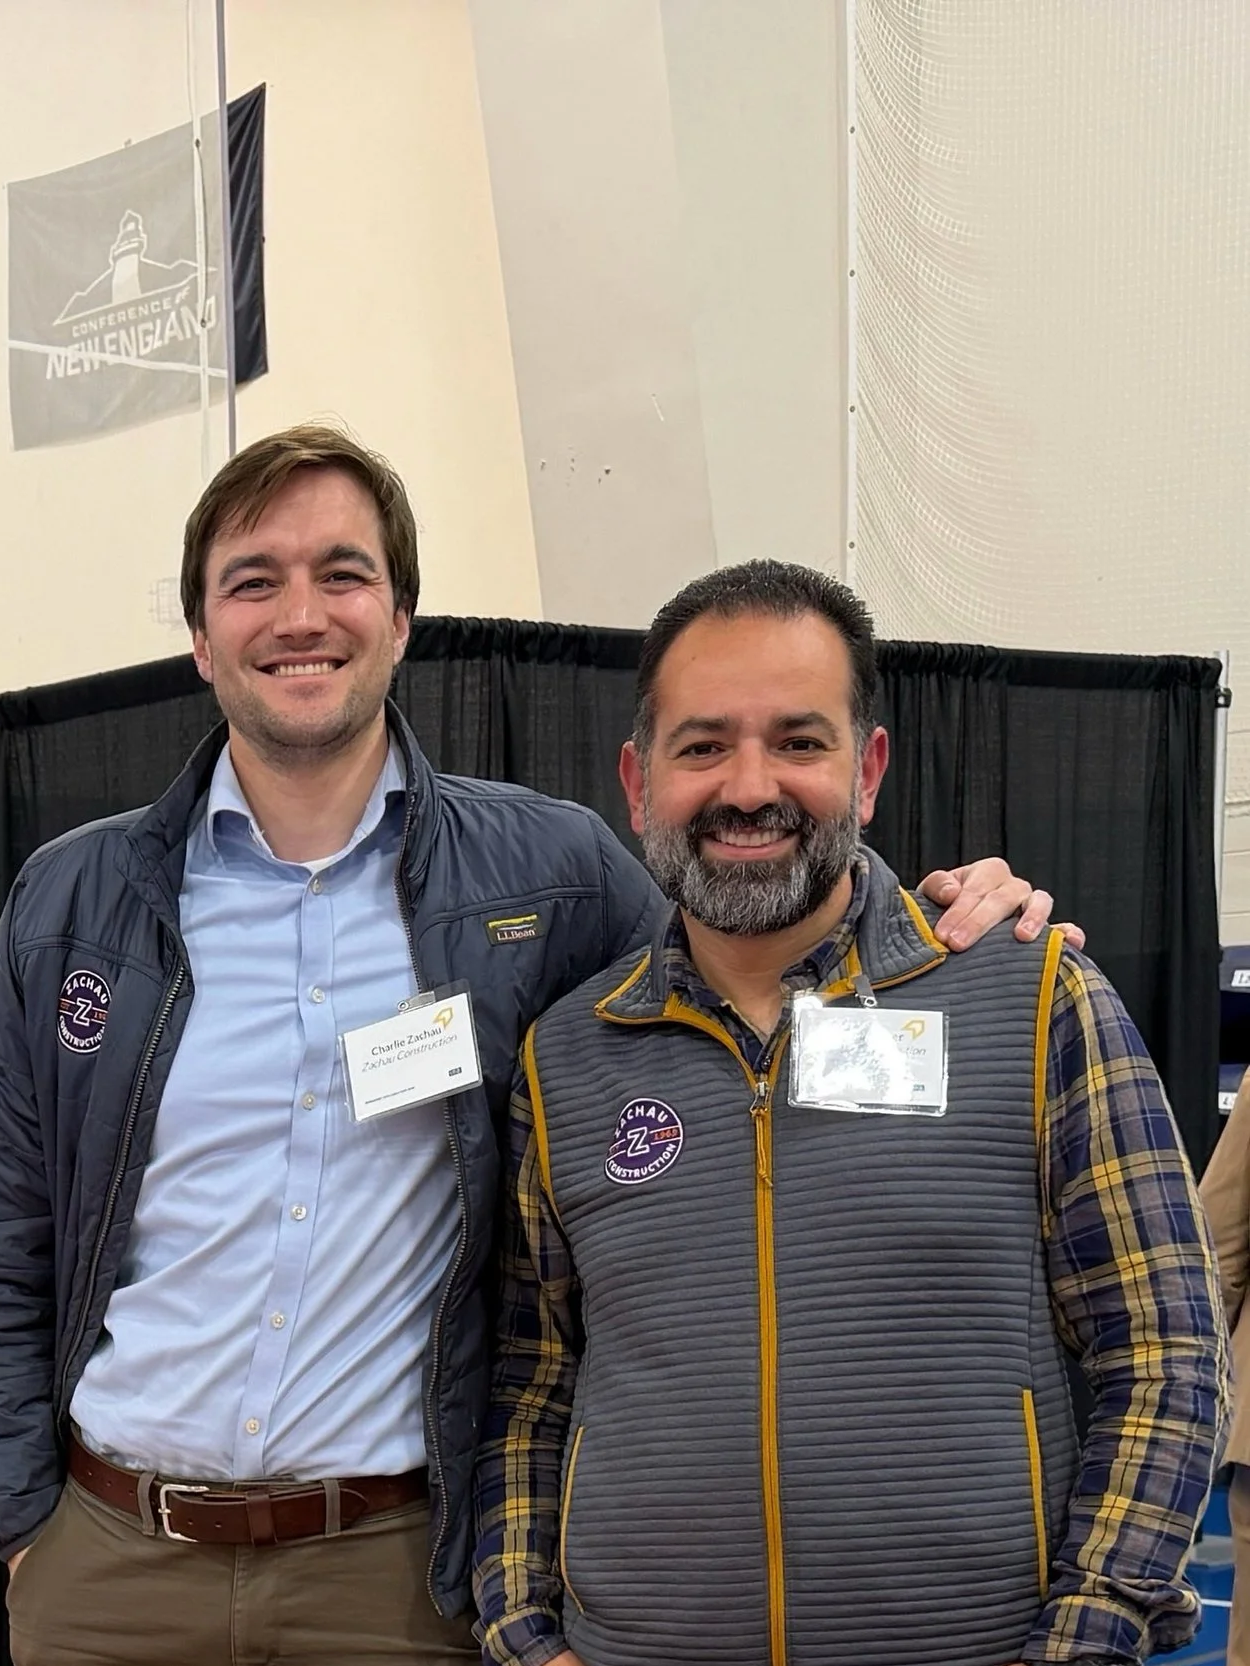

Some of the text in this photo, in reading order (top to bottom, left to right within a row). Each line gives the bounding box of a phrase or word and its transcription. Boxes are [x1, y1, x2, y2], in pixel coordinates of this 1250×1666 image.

[72, 297, 172, 338] CONFERENCE
[46, 295, 217, 380] NEW ENGLAND
[65, 976, 109, 1005] ZACHAU
[361, 1034, 458, 1073] Zachau Construction
[371, 1027, 442, 1057] Charlie Zachau
[614, 1105, 669, 1139] ZACHAU
[608, 1143, 678, 1178] CONSTRUCTION
